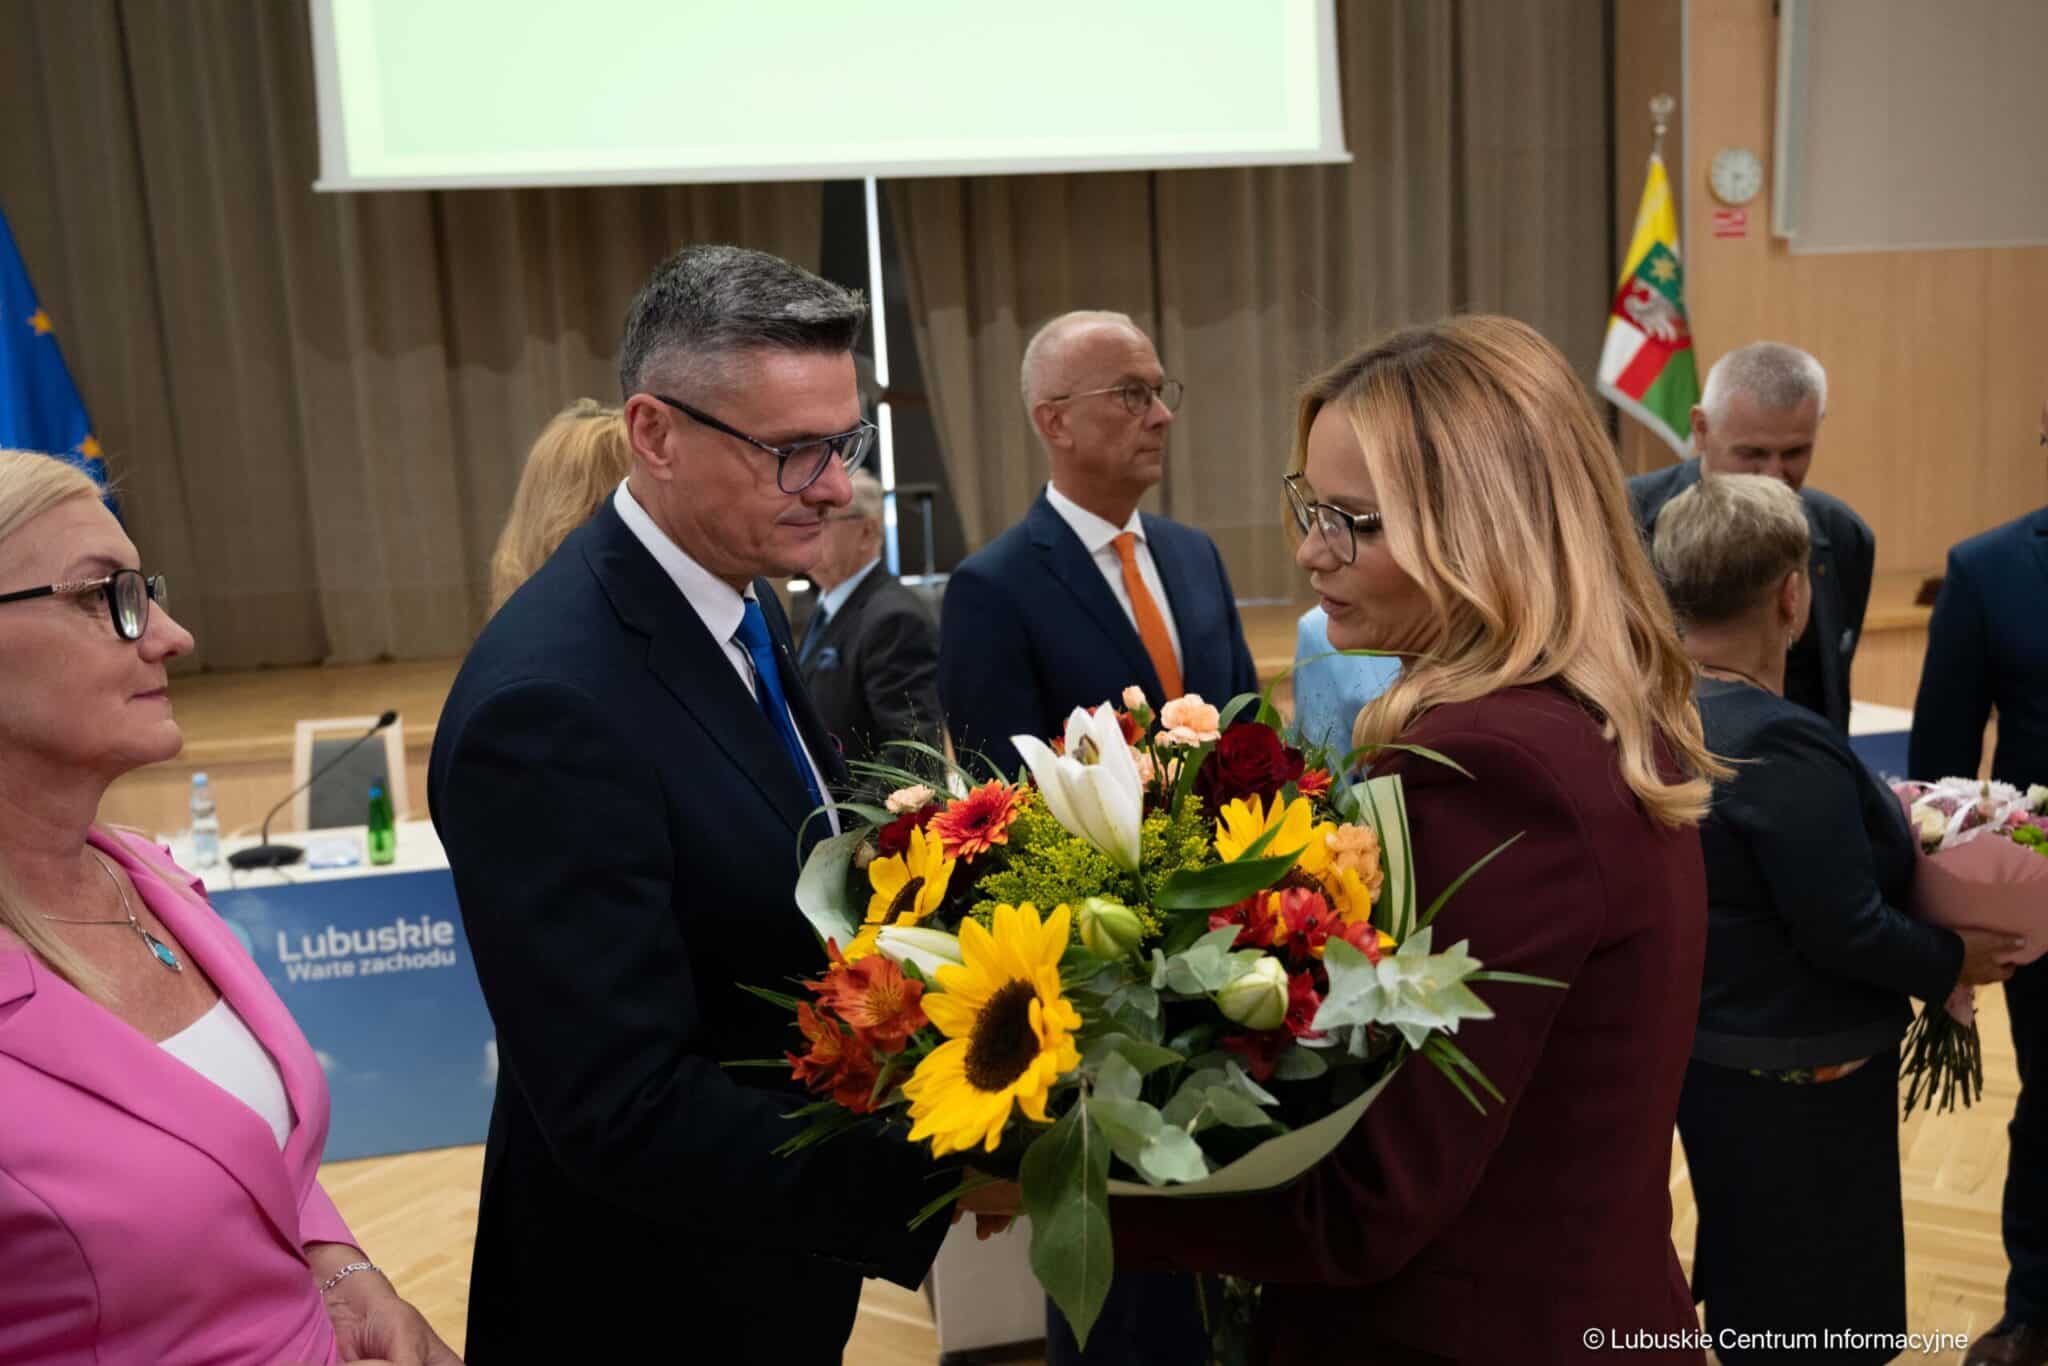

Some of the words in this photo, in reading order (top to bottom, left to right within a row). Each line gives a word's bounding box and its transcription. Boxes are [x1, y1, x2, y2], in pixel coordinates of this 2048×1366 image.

[278, 916, 455, 962] Lubuskie
[287, 960, 355, 982] Warte
[360, 949, 455, 975] zachodu
